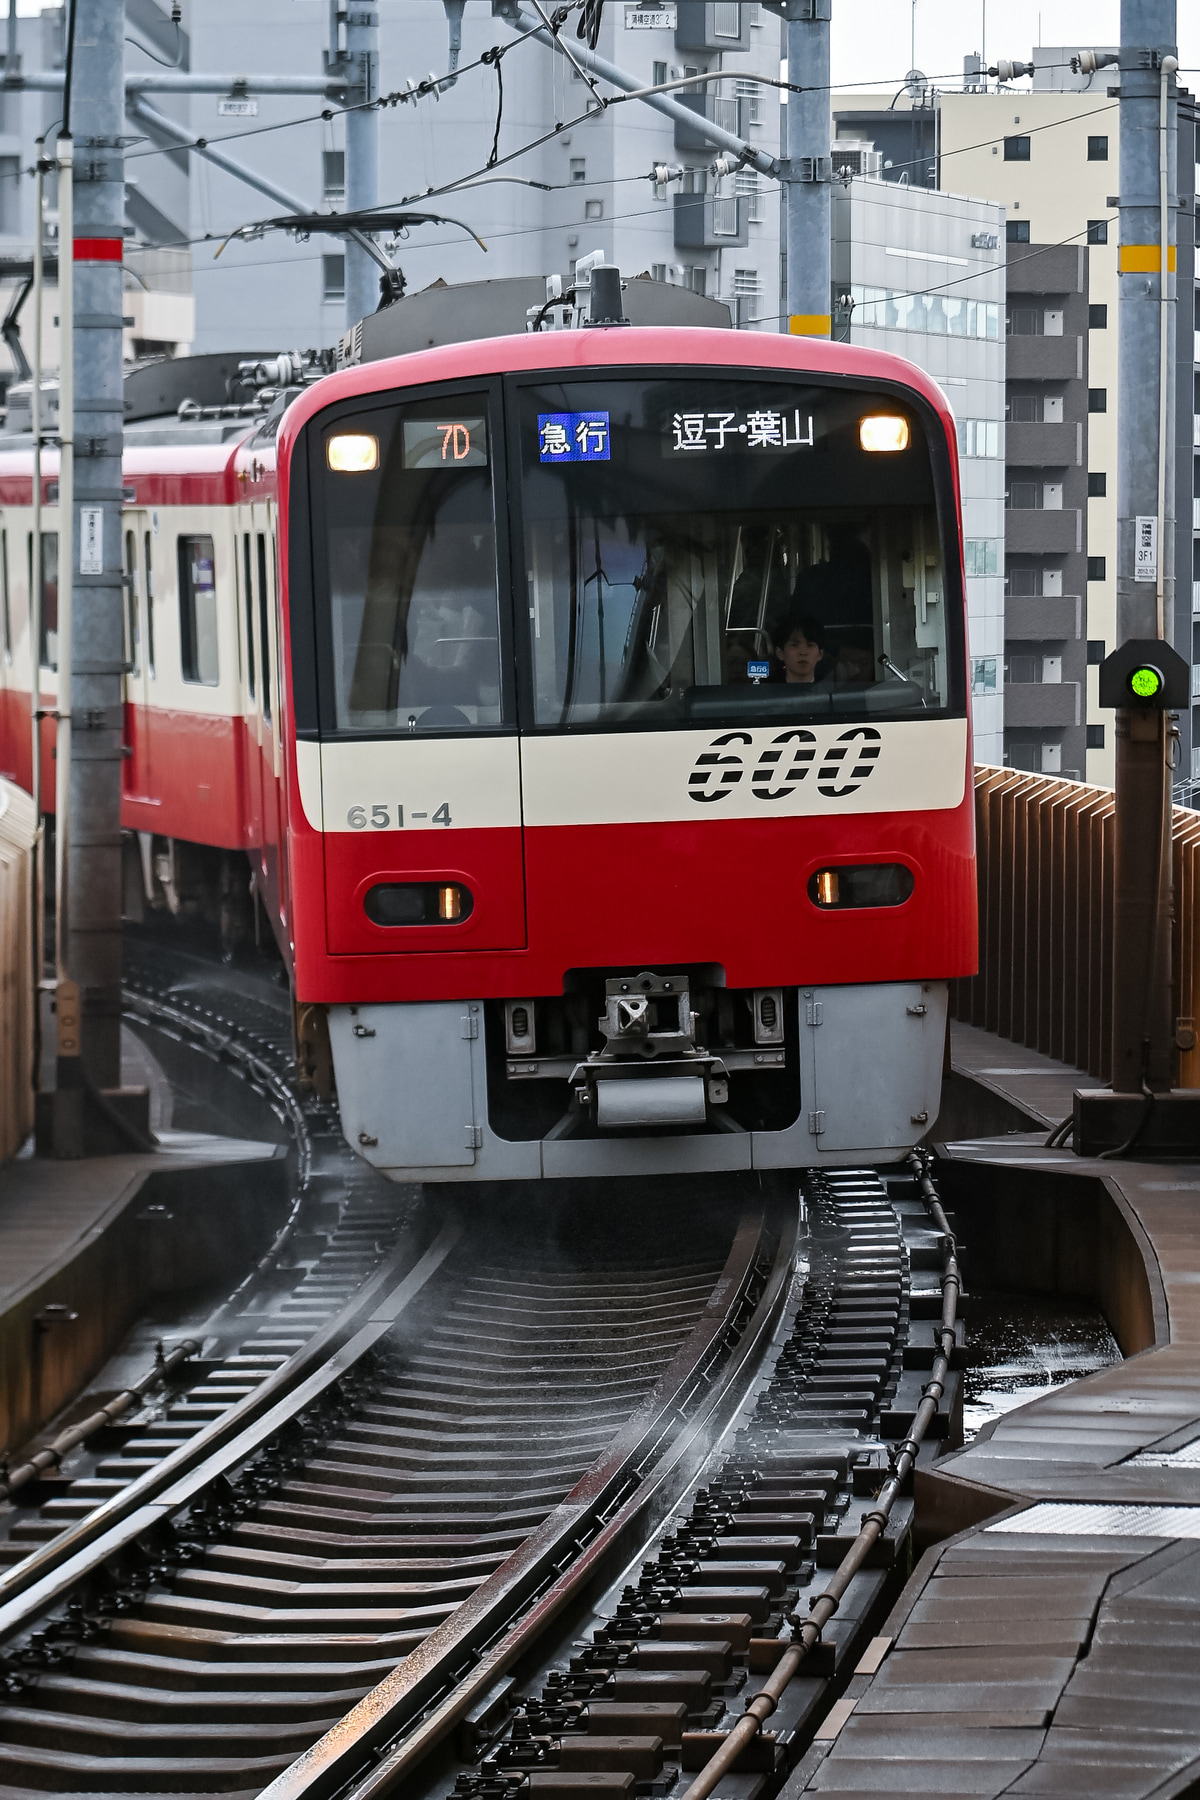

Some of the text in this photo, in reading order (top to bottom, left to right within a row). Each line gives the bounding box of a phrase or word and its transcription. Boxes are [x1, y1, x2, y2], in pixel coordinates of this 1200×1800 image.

[437, 424, 470, 460] 7D
[540, 420, 608, 455] 急行
[672, 409, 814, 450] 逗子・葉山
[1138, 550, 1153, 562] 3F1
[688, 727, 882, 803] 600
[347, 803, 452, 829] 651-4
